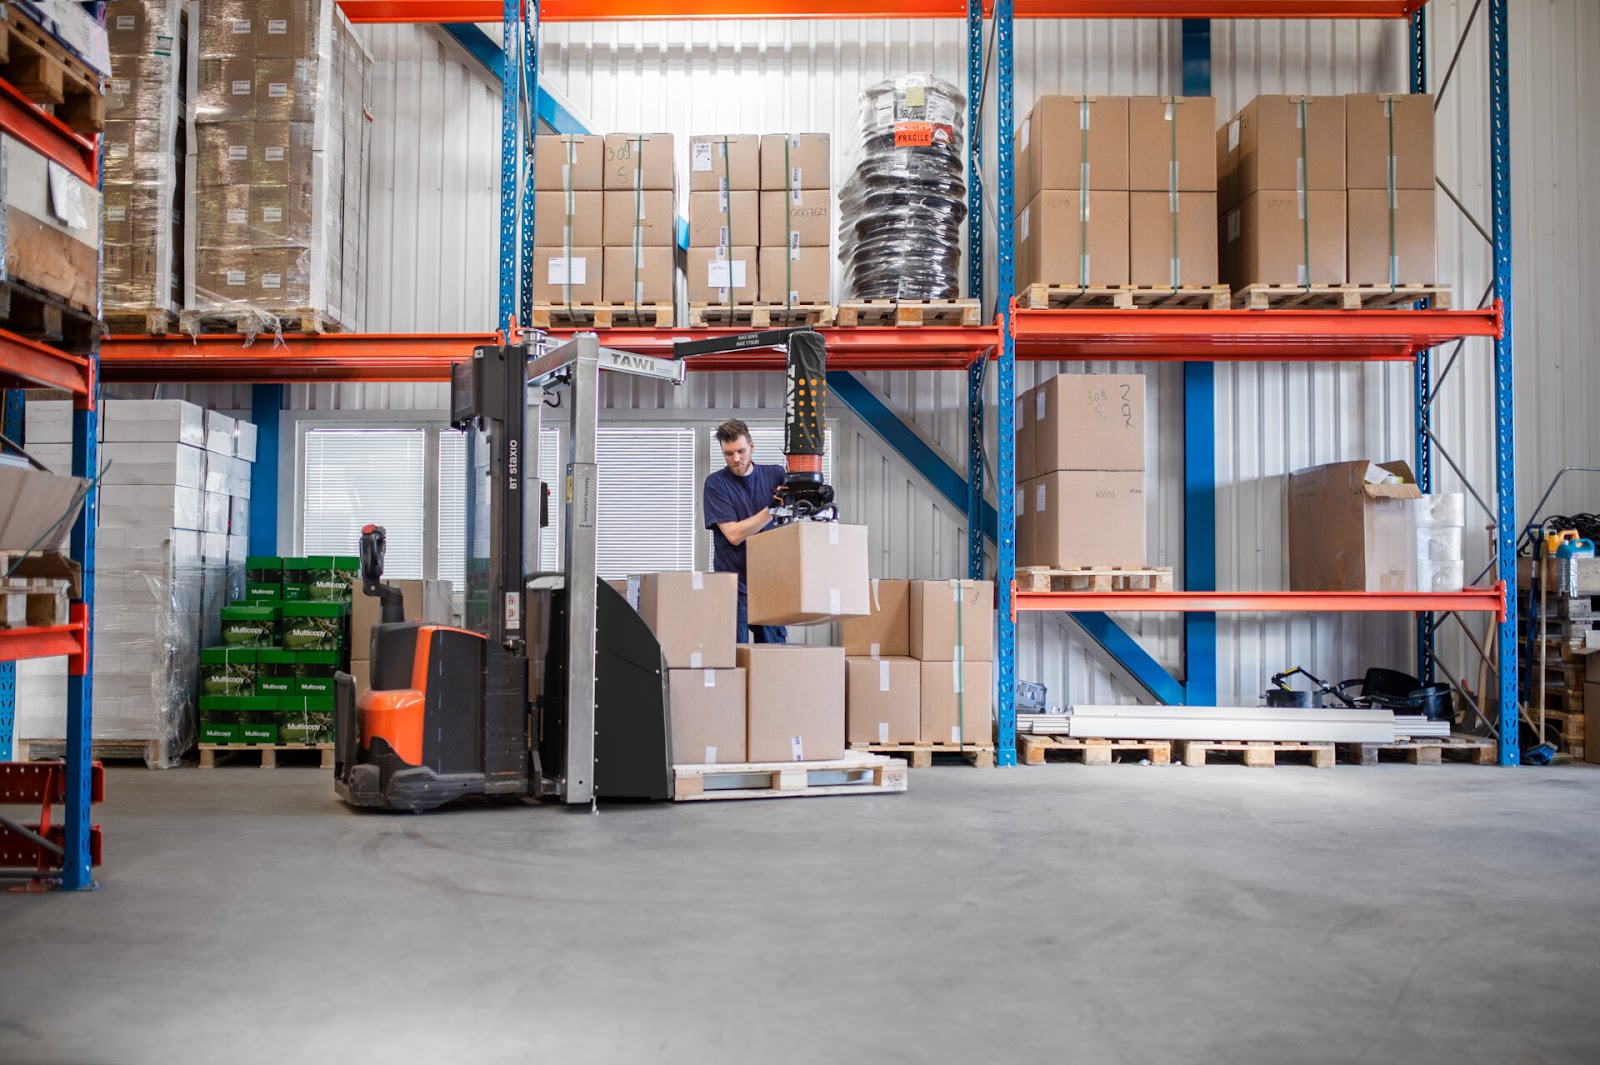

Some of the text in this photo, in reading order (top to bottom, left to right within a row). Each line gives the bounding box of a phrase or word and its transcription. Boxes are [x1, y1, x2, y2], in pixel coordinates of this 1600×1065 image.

[898, 134, 929, 142] FRAGILE
[611, 353, 655, 371] TAWI
[786, 364, 796, 424] TAWI
[509, 477, 517, 490] BT
[316, 581, 346, 589] Multicopy
[231, 626, 264, 634] Multicopy
[292, 629, 326, 637] Multicopy
